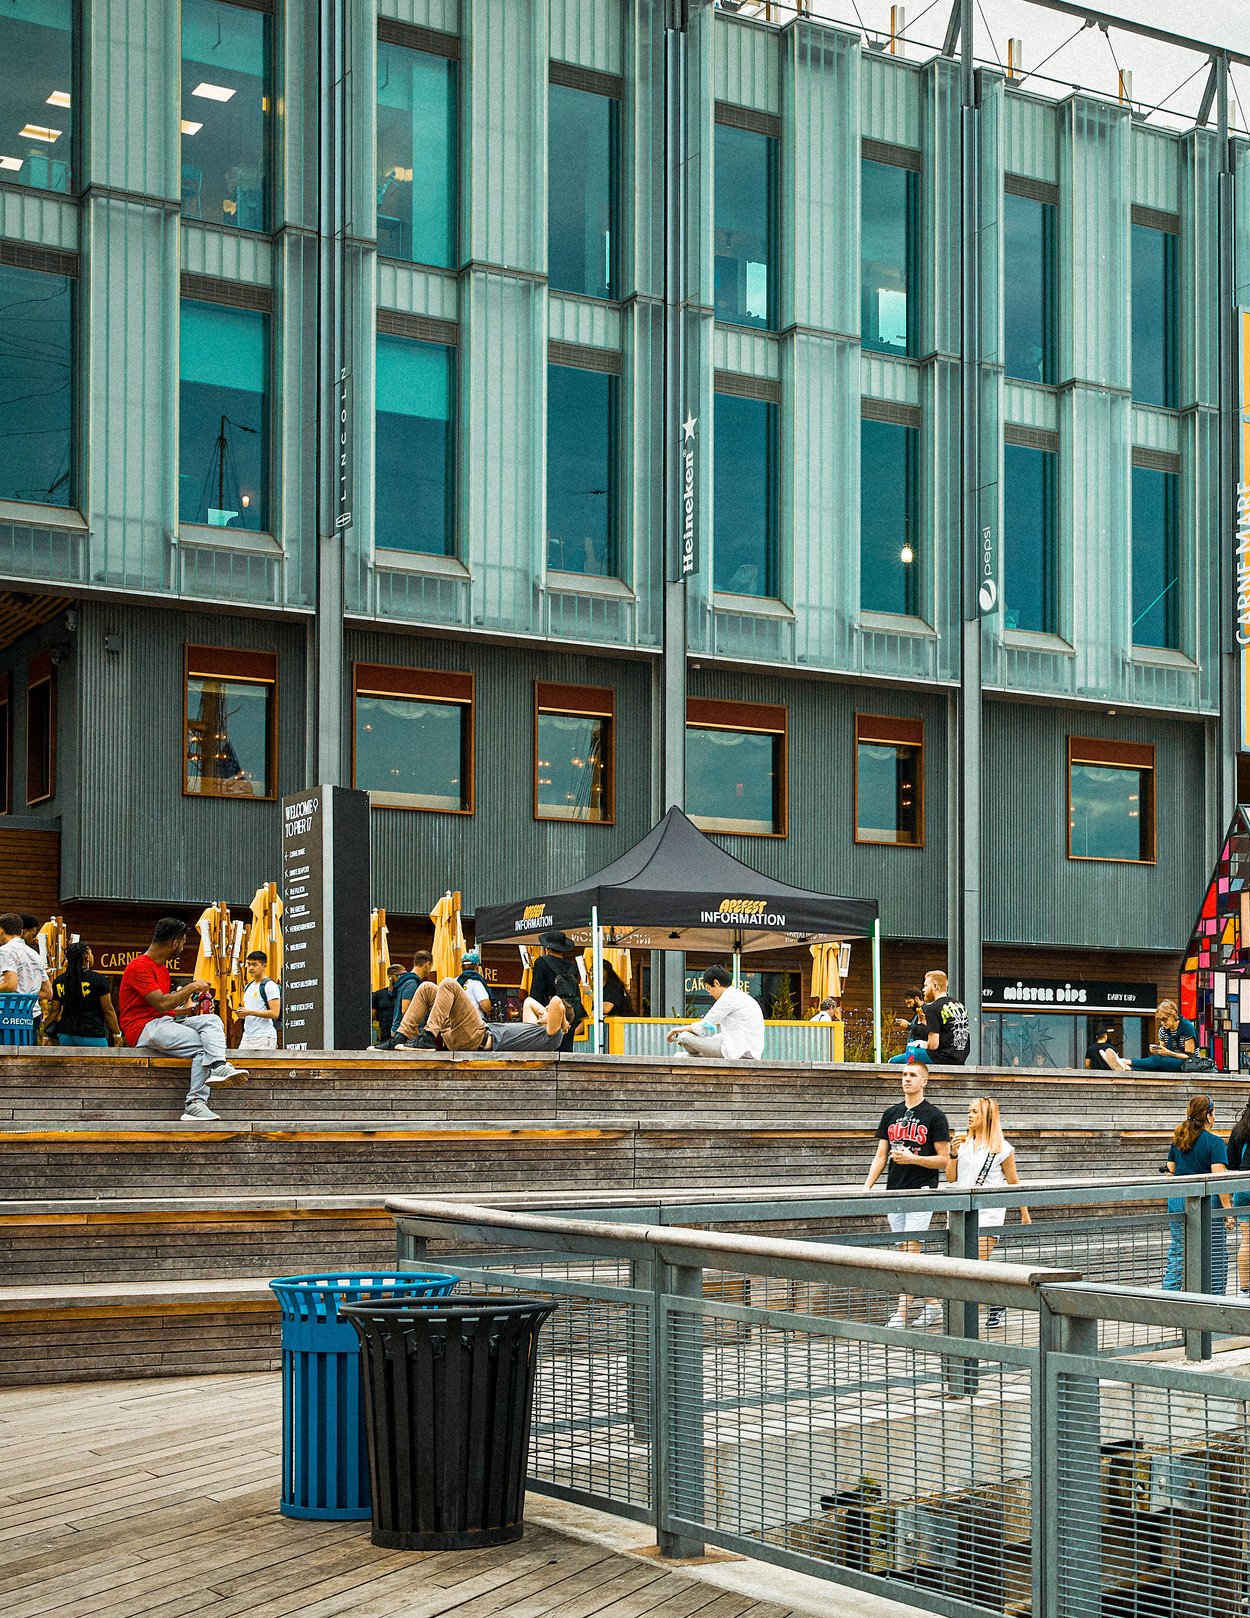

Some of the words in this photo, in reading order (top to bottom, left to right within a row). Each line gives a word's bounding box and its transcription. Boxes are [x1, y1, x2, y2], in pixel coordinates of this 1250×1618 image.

[683, 450, 694, 574] Heineken
[982, 526, 992, 576] pepsi
[285, 799, 313, 821] WELCOME
[285, 821, 294, 838] TO
[294, 818, 306, 836] PIER
[719, 899, 768, 914] APEFEST
[515, 915, 553, 931] INFORMATION
[701, 911, 785, 926] INFORMATION
[887, 1121, 928, 1146] BULLS
